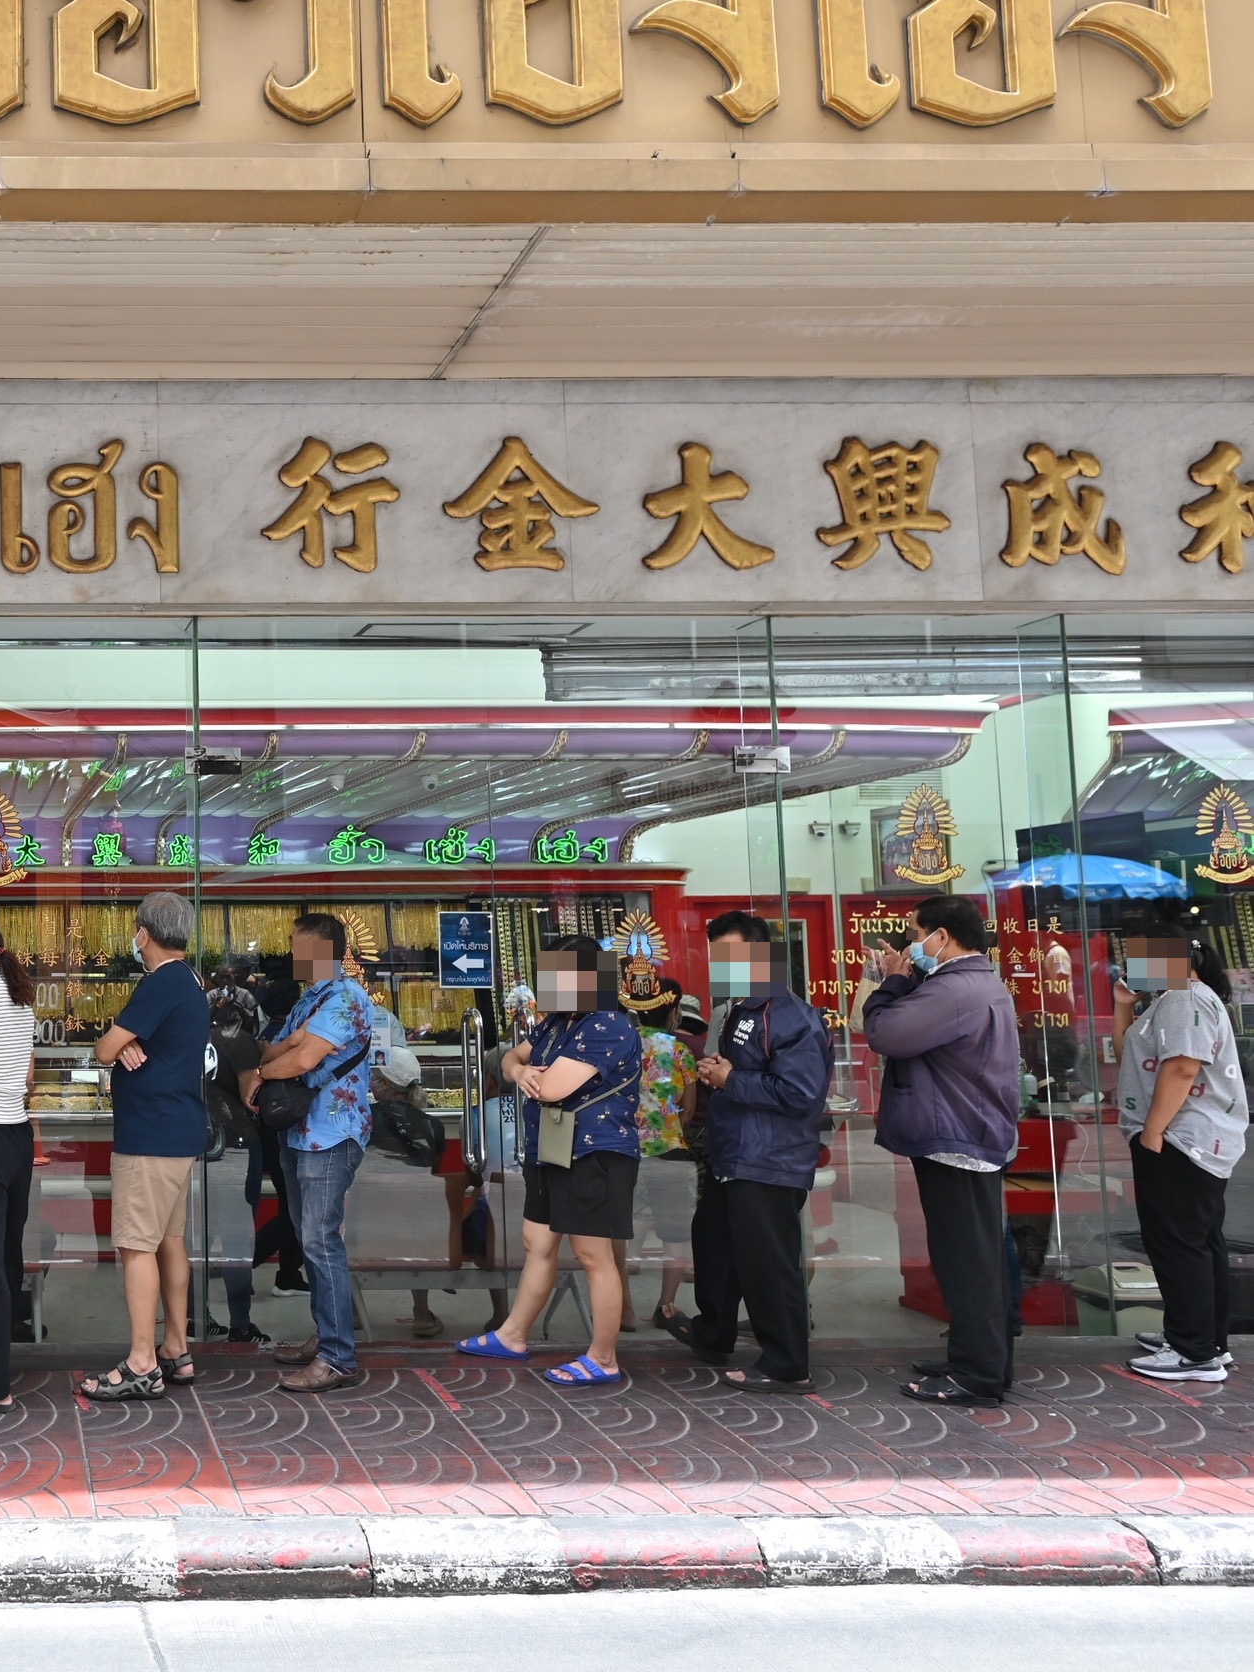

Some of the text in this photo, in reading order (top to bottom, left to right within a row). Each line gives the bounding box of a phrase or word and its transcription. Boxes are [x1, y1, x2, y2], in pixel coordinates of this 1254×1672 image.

[443, 939, 489, 951] เปิดให้บริการ
[1031, 979, 1067, 995] บาท
[1034, 1012, 1069, 1028] บาท
